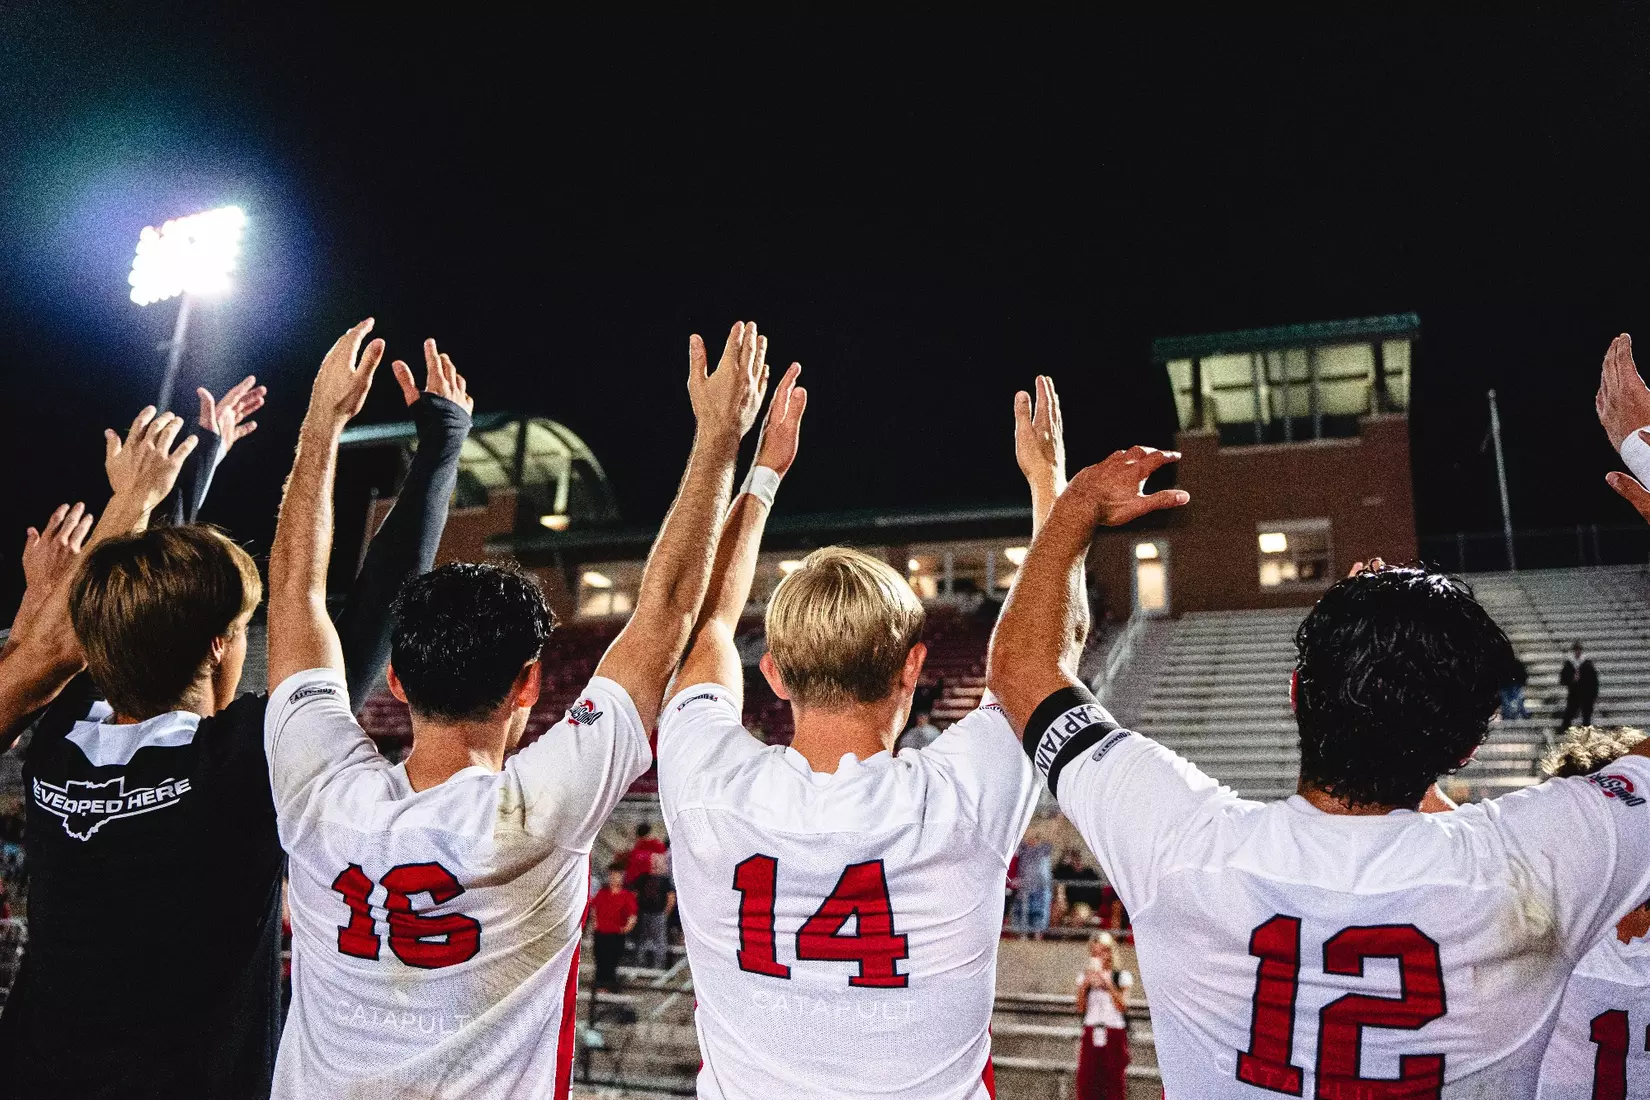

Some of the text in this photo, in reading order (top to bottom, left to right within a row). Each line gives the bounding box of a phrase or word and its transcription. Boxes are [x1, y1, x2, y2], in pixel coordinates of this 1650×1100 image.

[1036, 705, 1105, 777] CAPTAIN
[127, 778, 192, 810] HERE
[332, 862, 482, 969] 16
[732, 853, 909, 988] 14
[337, 1001, 470, 1034] CATAPULT
[1236, 913, 1447, 1100] 12
[1589, 1009, 1650, 1100] 1
